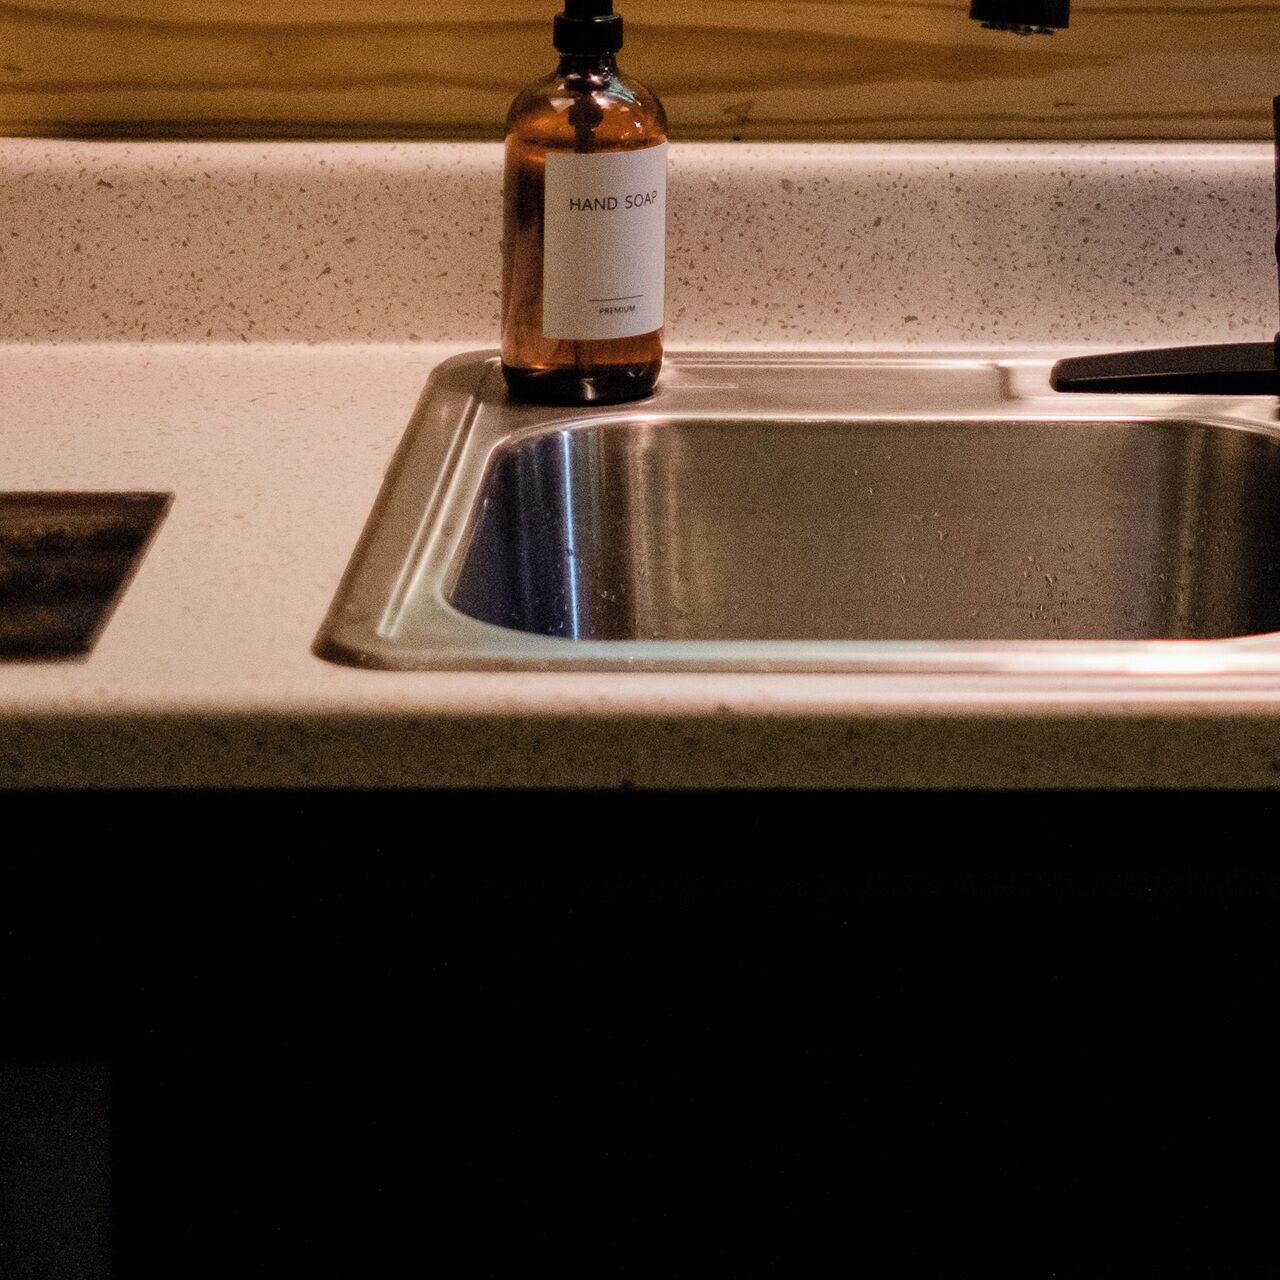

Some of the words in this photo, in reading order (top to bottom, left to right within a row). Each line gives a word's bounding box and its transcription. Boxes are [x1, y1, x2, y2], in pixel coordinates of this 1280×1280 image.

[569, 196, 618, 211] HAND
[625, 190, 658, 210] SOAP
[600, 304, 636, 316] PREMIUM
